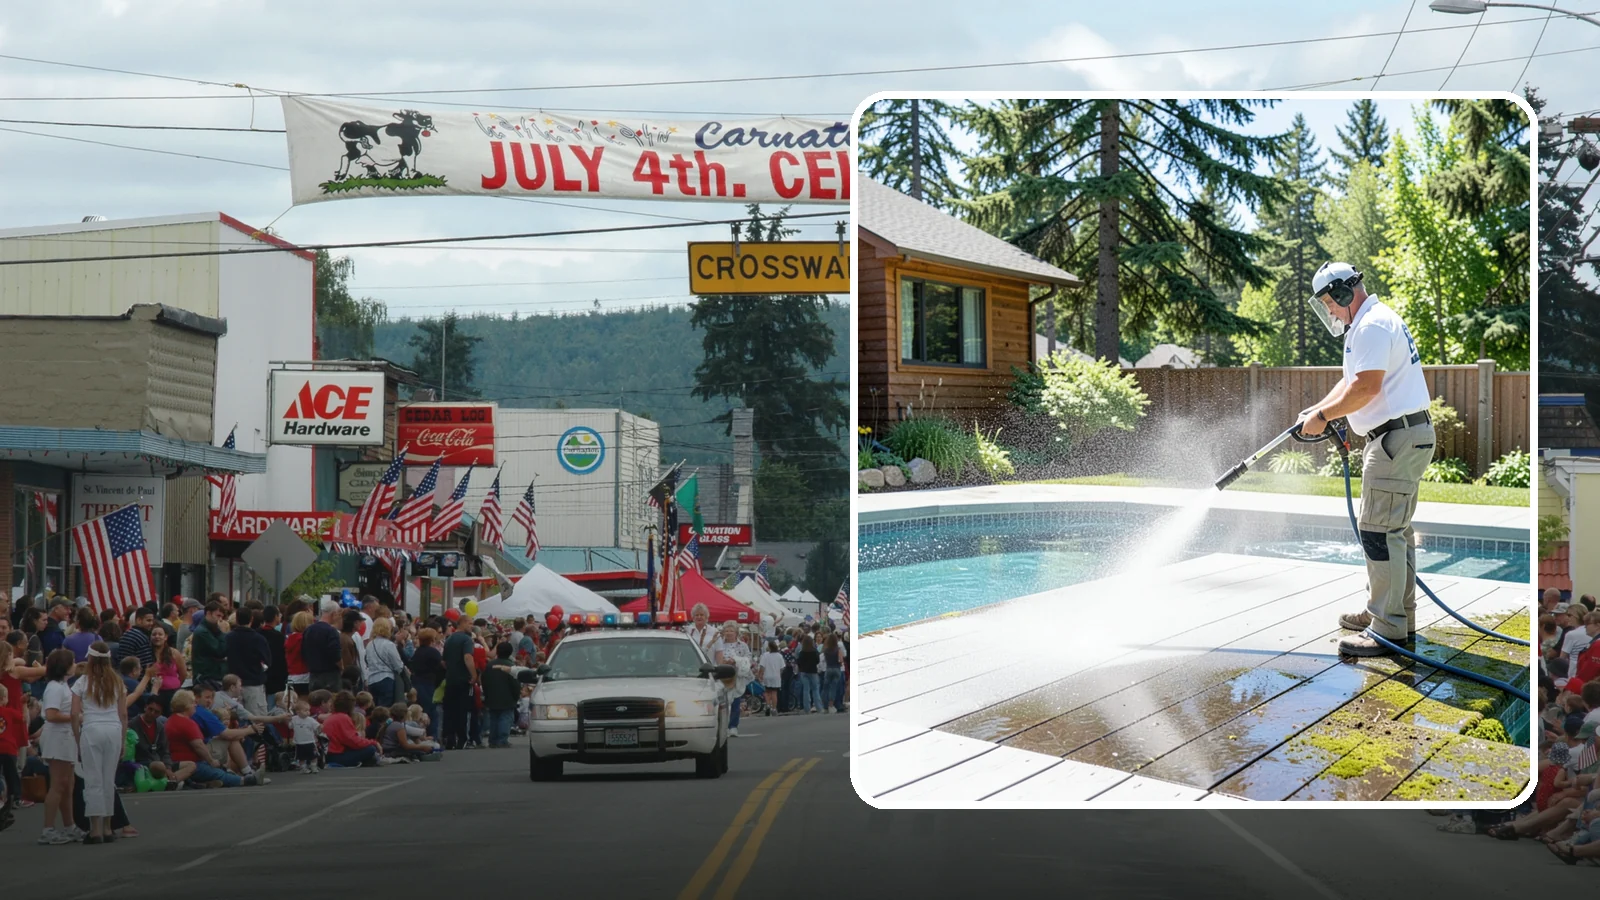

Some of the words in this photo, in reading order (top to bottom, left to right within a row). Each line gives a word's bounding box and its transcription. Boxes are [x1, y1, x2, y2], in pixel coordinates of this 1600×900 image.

[481, 141, 605, 191] JULY
[632, 150, 746, 197] 4th.
[697, 254, 850, 279] CROSSWA
[282, 380, 373, 420] ACE
[406, 409, 452, 422] CEDAR
[283, 421, 370, 436] Hardware
[83, 484, 94, 494] St.
[96, 485, 124, 494] Vincent
[126, 486, 135, 494] de
[137, 486, 155, 495] Paul
[688, 526, 741, 535] CRNATION
[699, 535, 730, 543] GLASS
